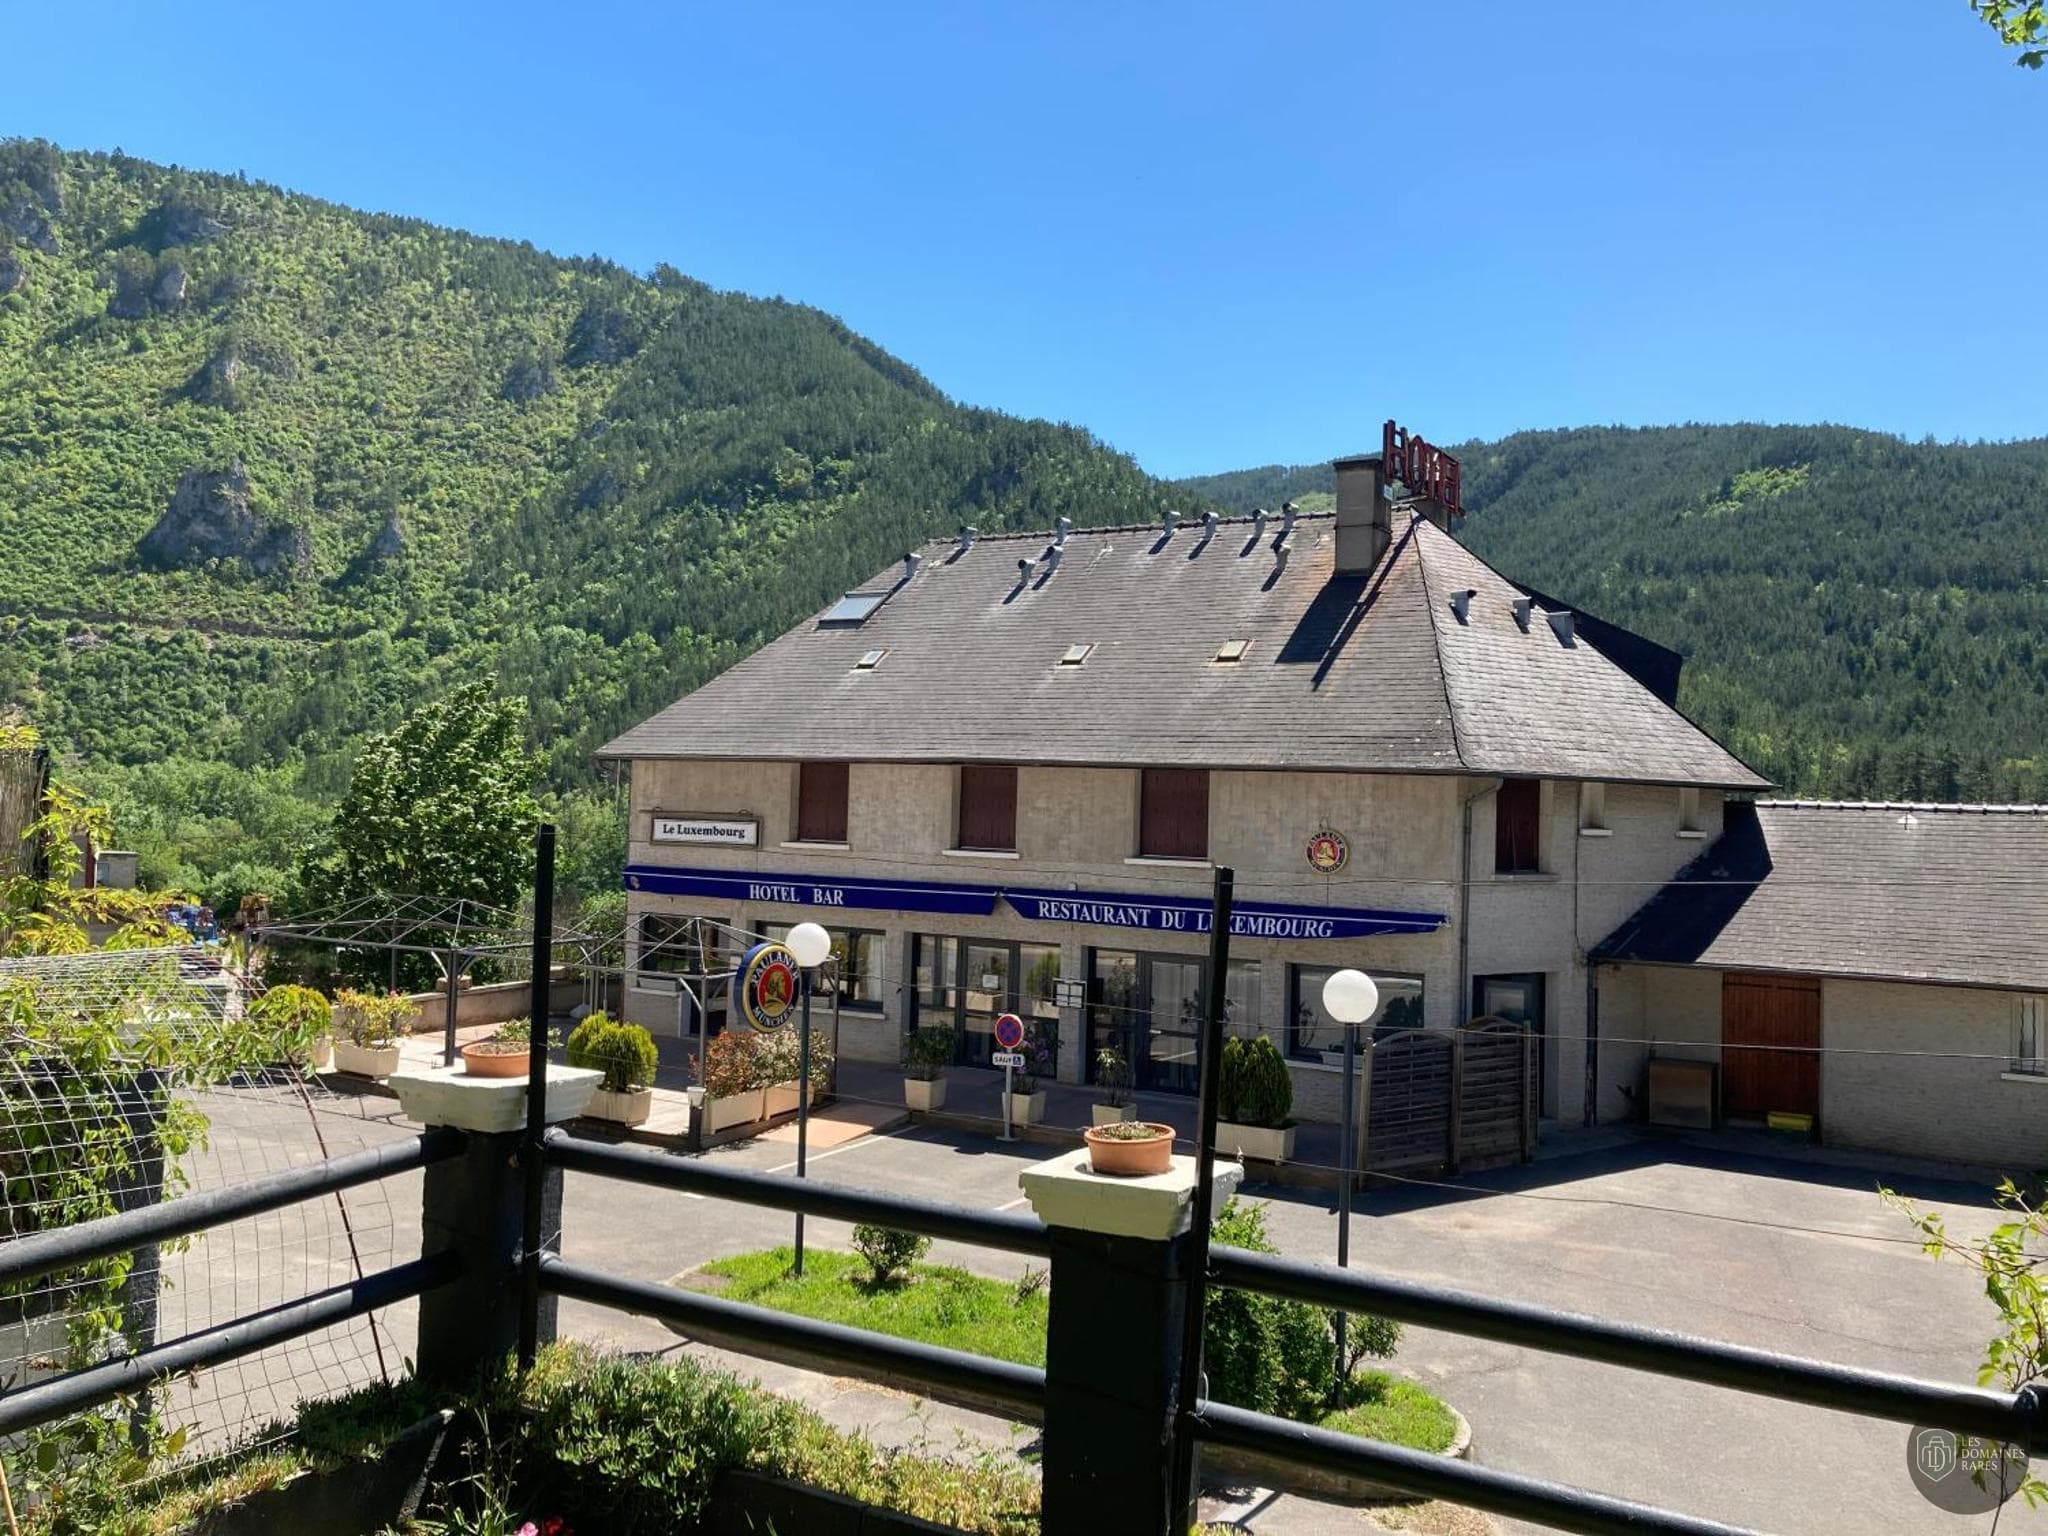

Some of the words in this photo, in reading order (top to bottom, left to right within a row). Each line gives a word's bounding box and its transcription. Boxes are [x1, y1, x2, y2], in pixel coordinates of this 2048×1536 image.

[663, 824, 675, 836] Le
[677, 824, 745, 839] Luxembourg
[749, 884, 800, 903] HOTEL
[813, 888, 844, 906] BAR
[1038, 900, 1151, 927] RESTAURANT
[1161, 911, 1186, 929] DU
[1197, 913, 1334, 938] LEMBOURG
